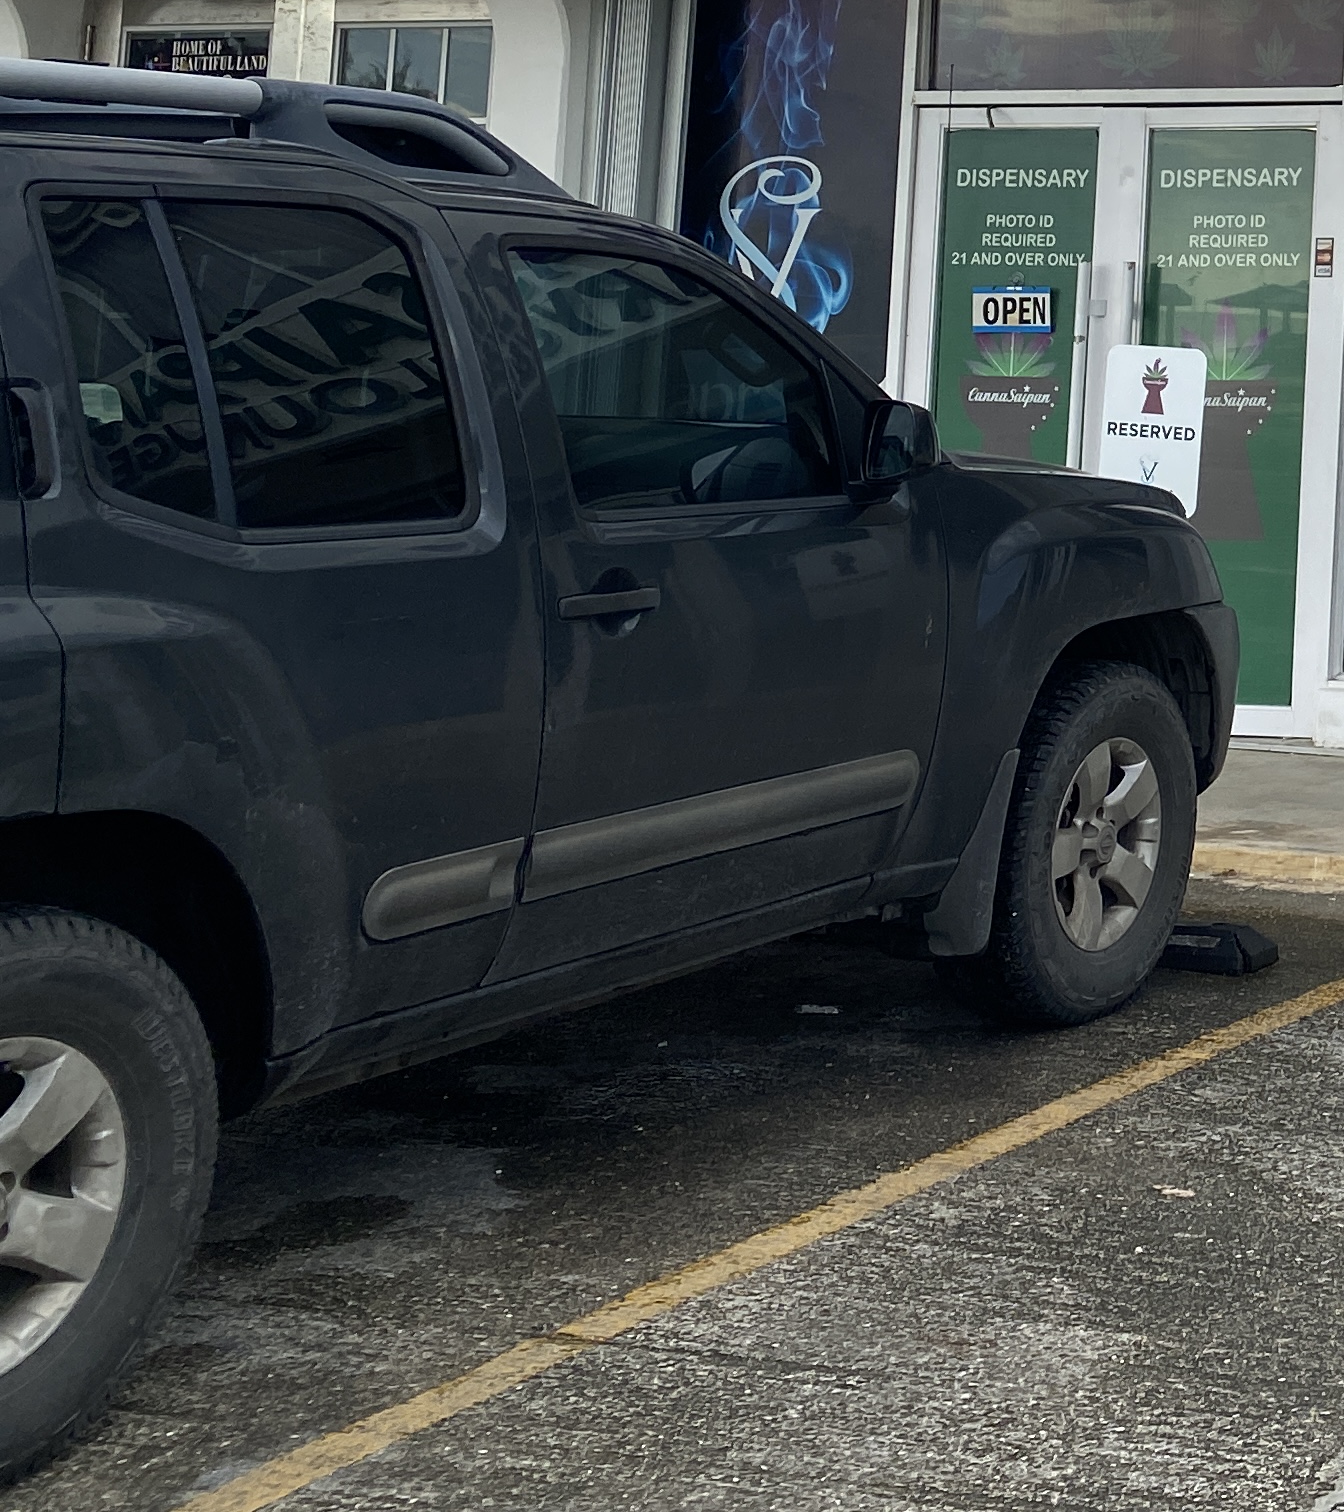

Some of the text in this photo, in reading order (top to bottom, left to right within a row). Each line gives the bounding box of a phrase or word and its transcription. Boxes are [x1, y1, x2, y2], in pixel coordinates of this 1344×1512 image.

[172, 40, 206, 56] HOME
[956, 168, 1089, 188] DISPENSARY
[1160, 167, 1302, 188] DISPENSARY
[986, 214, 1054, 228] PHOTO ID
[1193, 214, 1266, 229] PHOTO ID
[981, 233, 1056, 248] REQUIRED
[1189, 233, 1269, 248] REQUIRED
[951, 252, 1086, 267] 21 AND OVER ONLY
[1157, 253, 1300, 268] 21 AND OVER ONLY
[982, 296, 1047, 326] OPEN
[967, 387, 1052, 408] CannaSaipan
[1203, 390, 1268, 413] naSaipan
[1107, 421, 1196, 441] RESERVED
